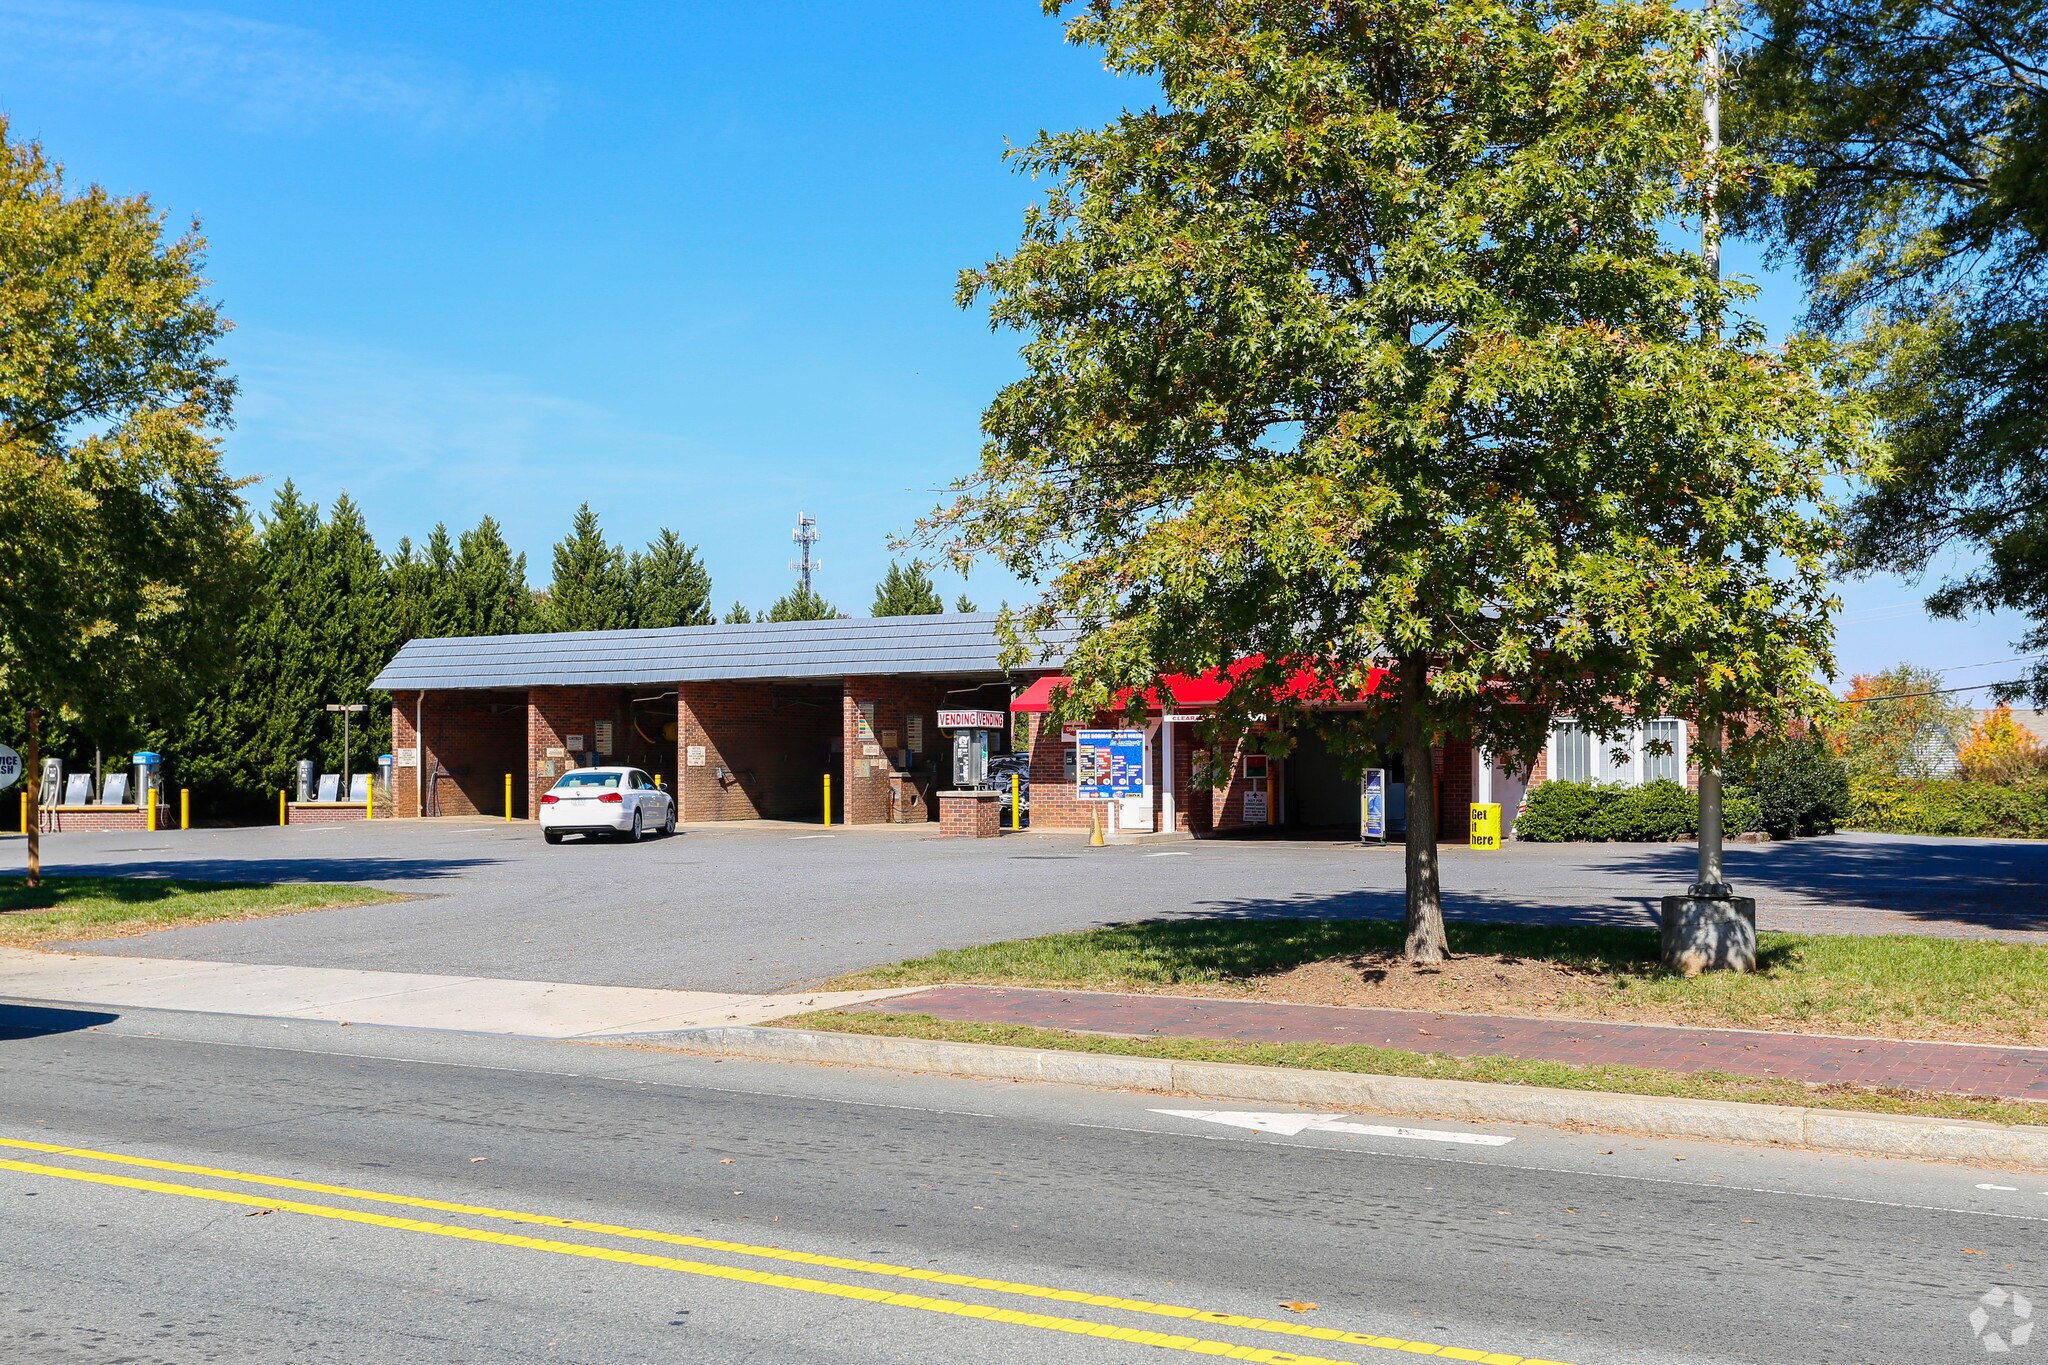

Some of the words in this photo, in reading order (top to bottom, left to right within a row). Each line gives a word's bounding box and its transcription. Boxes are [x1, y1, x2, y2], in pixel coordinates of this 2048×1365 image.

[939, 713, 976, 726] VENDING
[978, 713, 1003, 726] VENDING
[1471, 808, 1487, 820] Get
[1471, 821, 1477, 832] it
[1471, 834, 1494, 845] here
